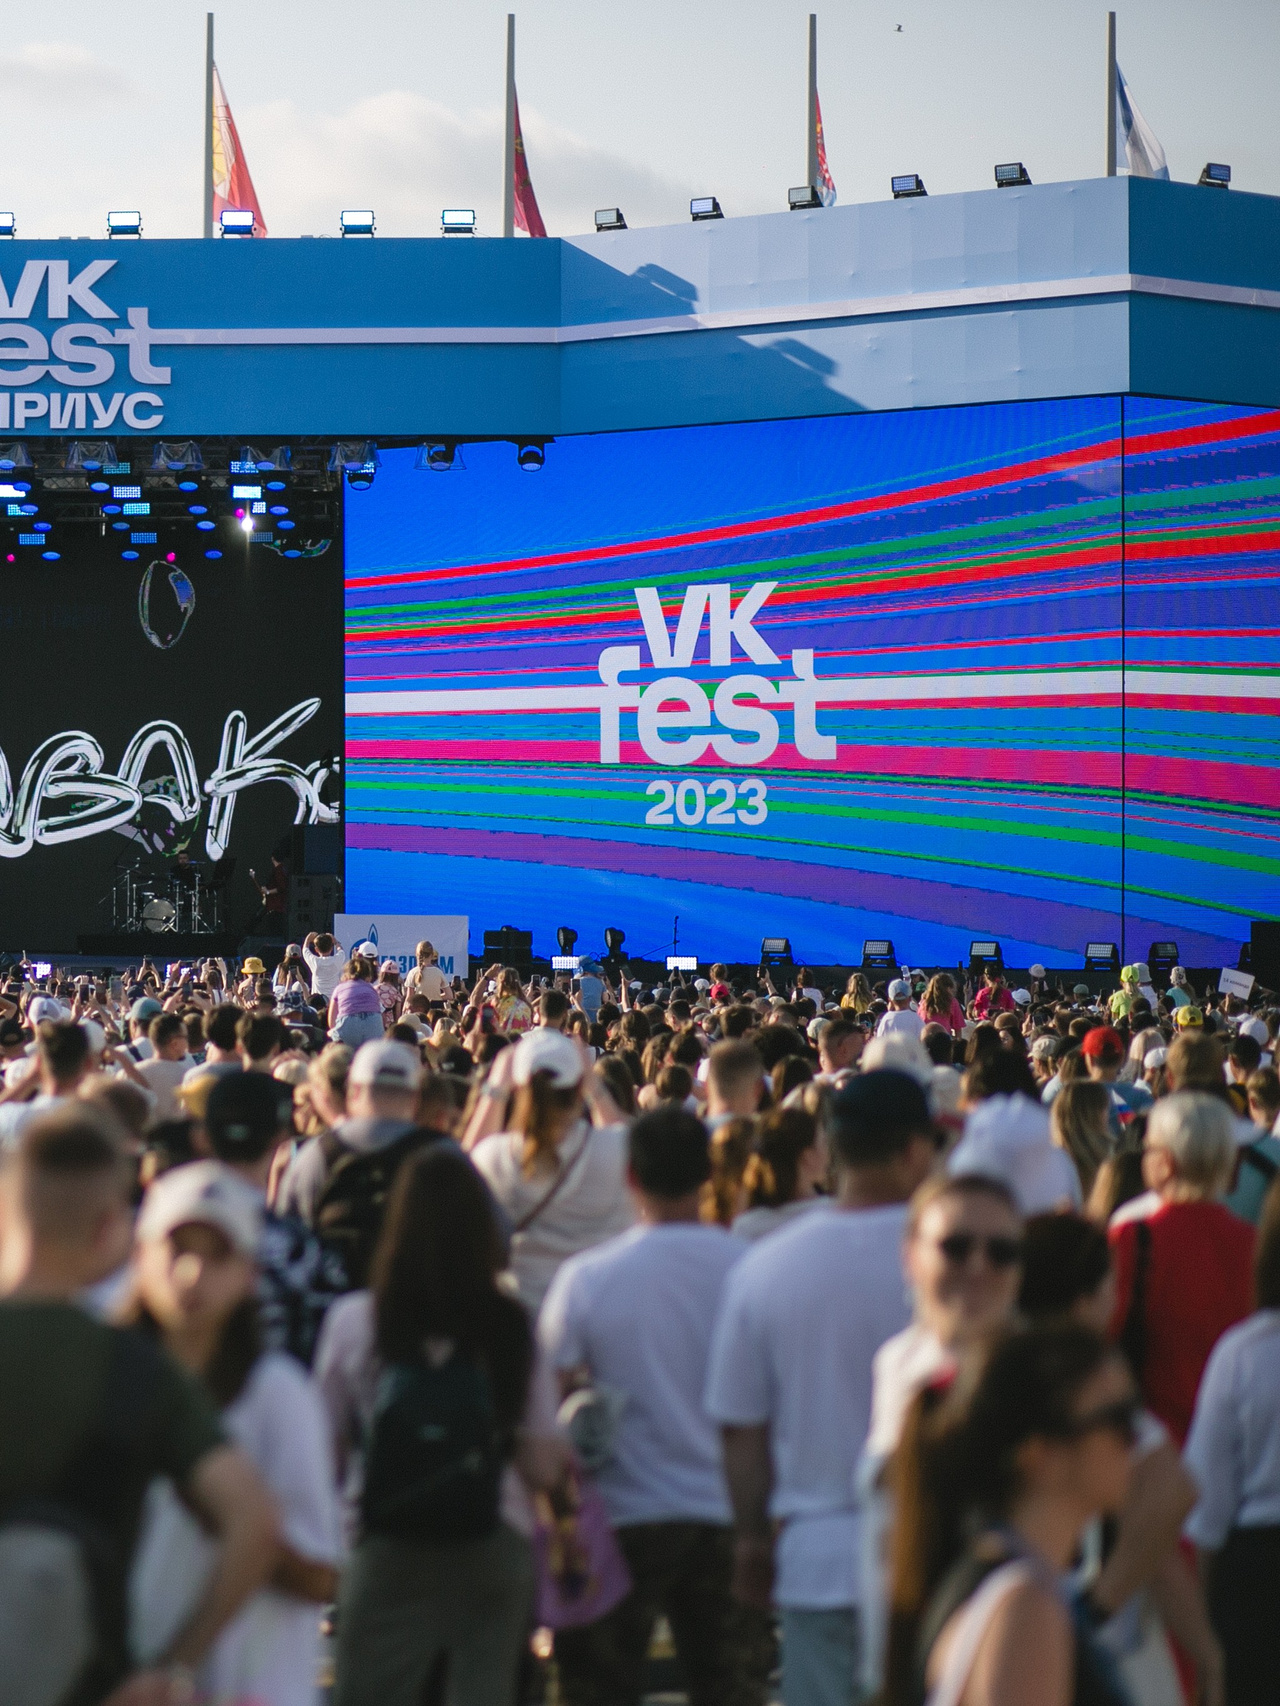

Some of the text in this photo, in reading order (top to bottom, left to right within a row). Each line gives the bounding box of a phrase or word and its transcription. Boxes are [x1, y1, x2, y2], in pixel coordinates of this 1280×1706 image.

[634, 581, 782, 669] VK
[598, 645, 837, 766] fest
[645, 778, 768, 826] 2023
